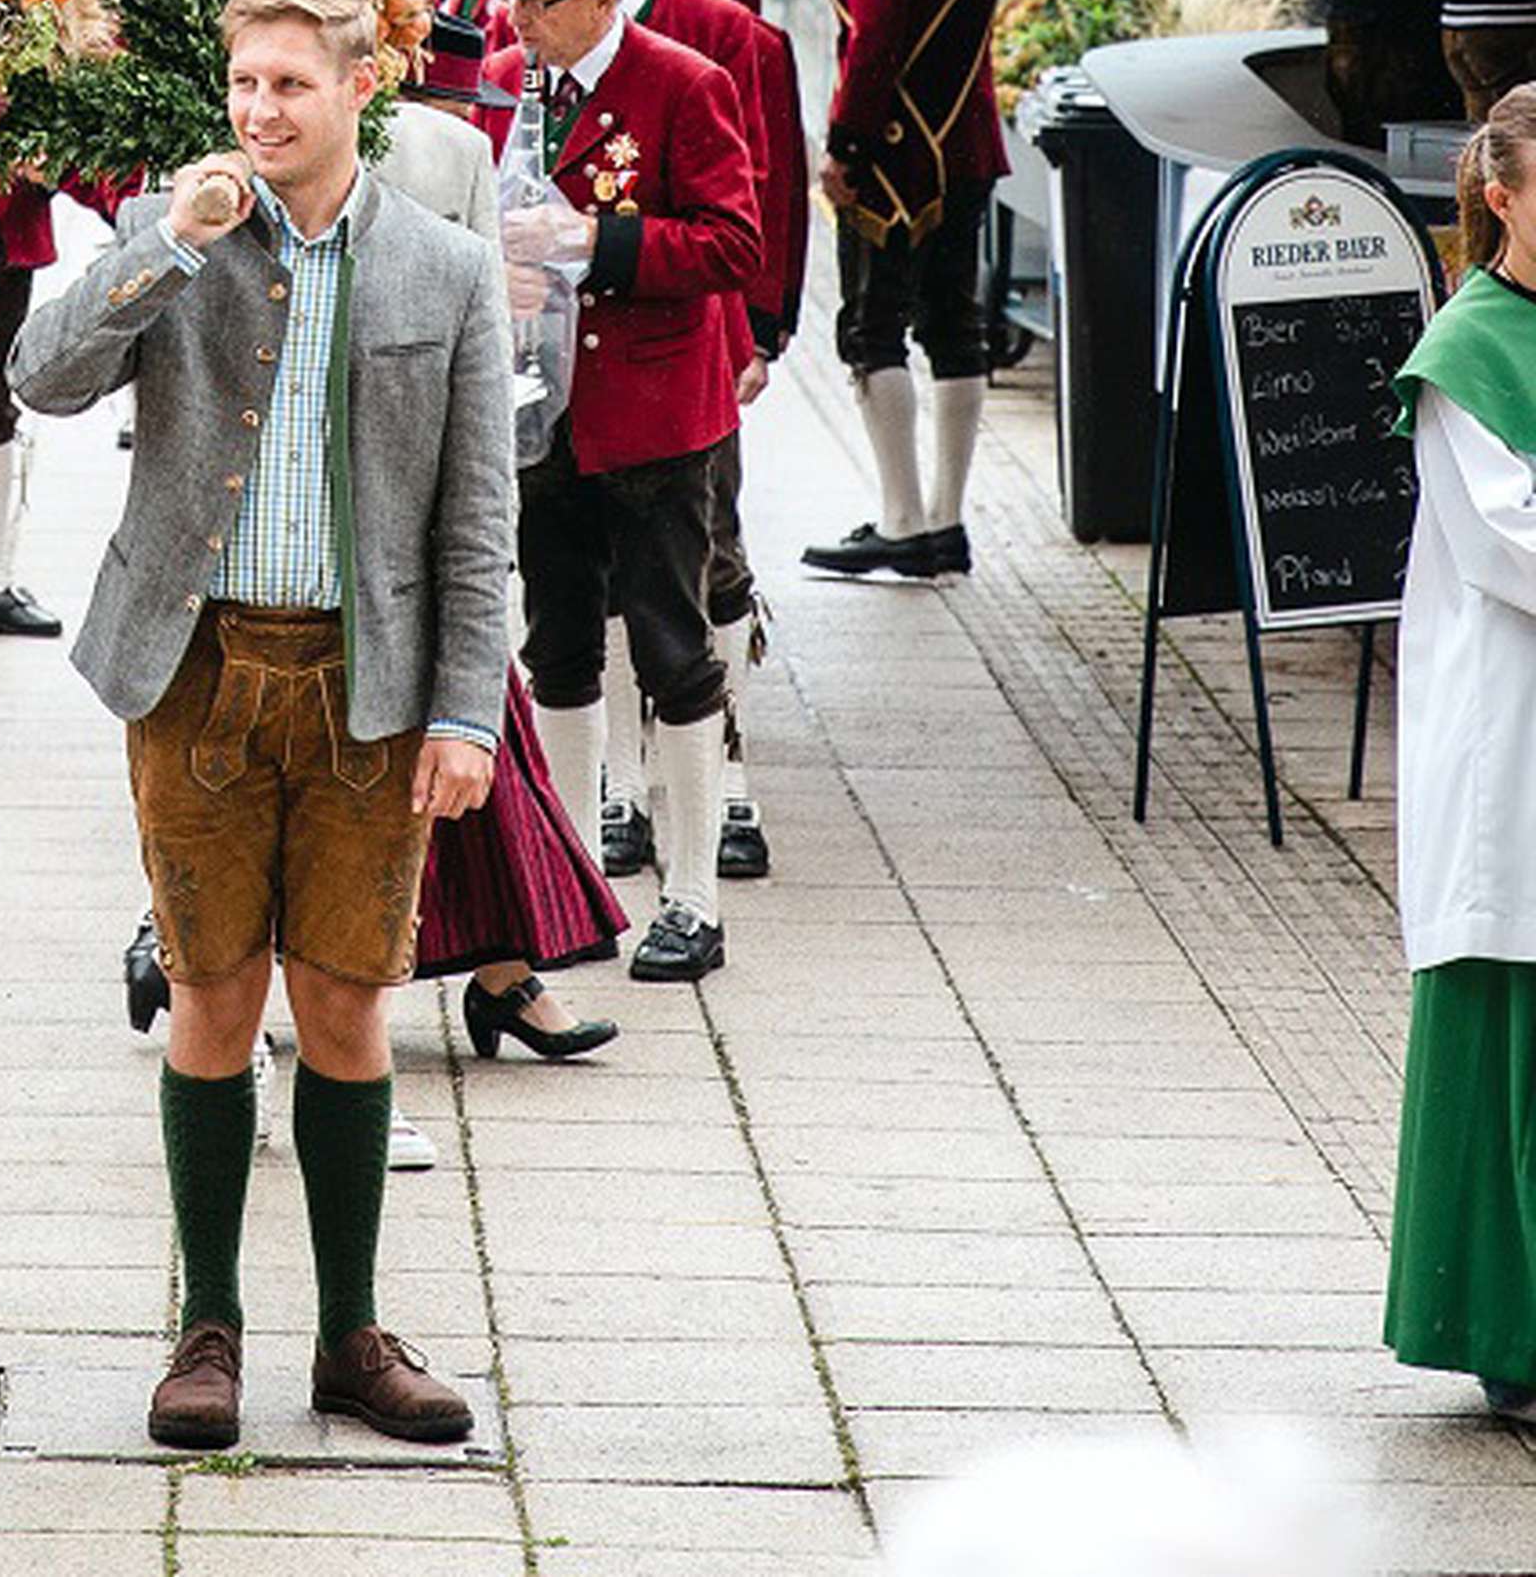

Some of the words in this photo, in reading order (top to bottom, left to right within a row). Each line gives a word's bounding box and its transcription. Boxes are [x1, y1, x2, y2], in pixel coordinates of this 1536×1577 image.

[1251, 240, 1331, 267] RIEDER
[1336, 236, 1387, 260] BIER
[1242, 312, 1306, 347] Bier
[1251, 369, 1315, 400] Limo
[1273, 553, 1353, 593] Pfand
